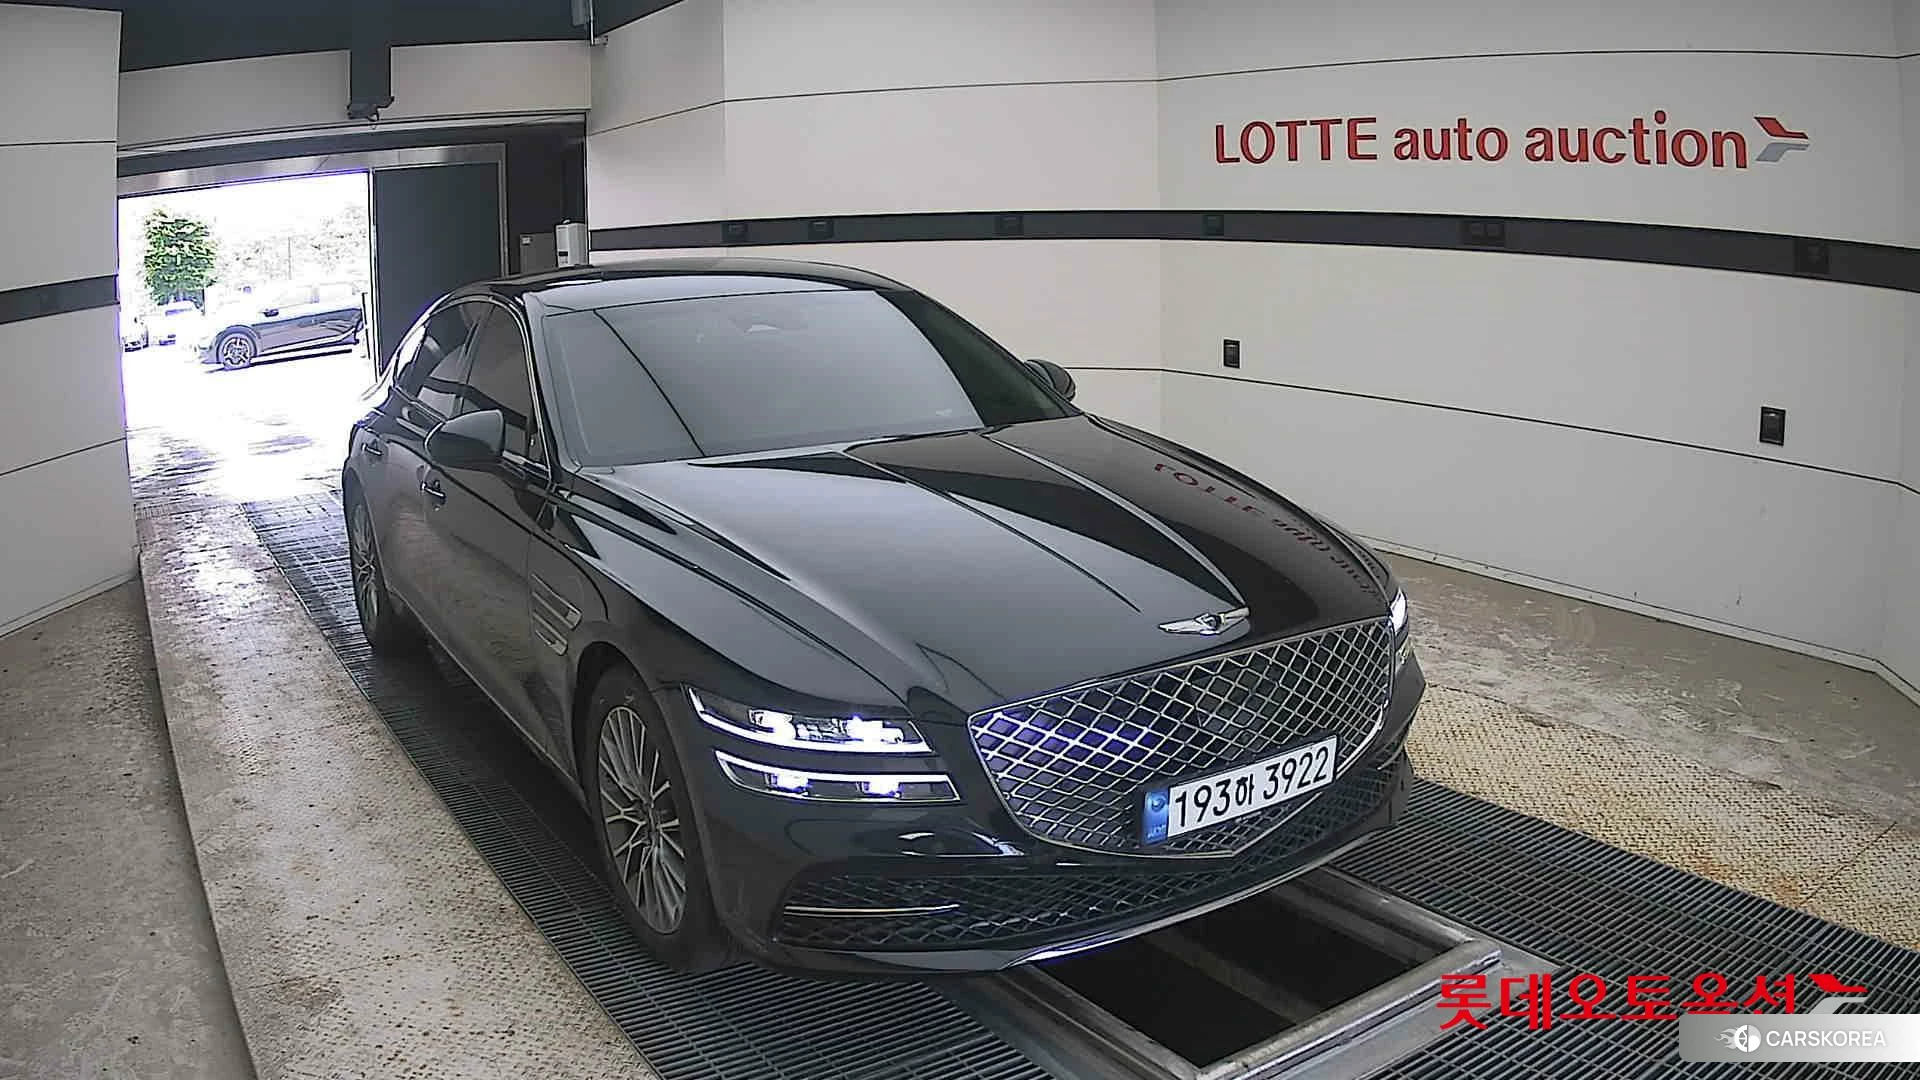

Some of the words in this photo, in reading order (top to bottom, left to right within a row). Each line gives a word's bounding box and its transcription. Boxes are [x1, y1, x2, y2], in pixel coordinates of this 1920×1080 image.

[1214, 116, 1378, 164] LOTTE
[1393, 117, 1511, 161] auto
[1523, 109, 1749, 169] auction
[1174, 773, 1255, 828] 193하
[1262, 745, 1330, 800] 3922
